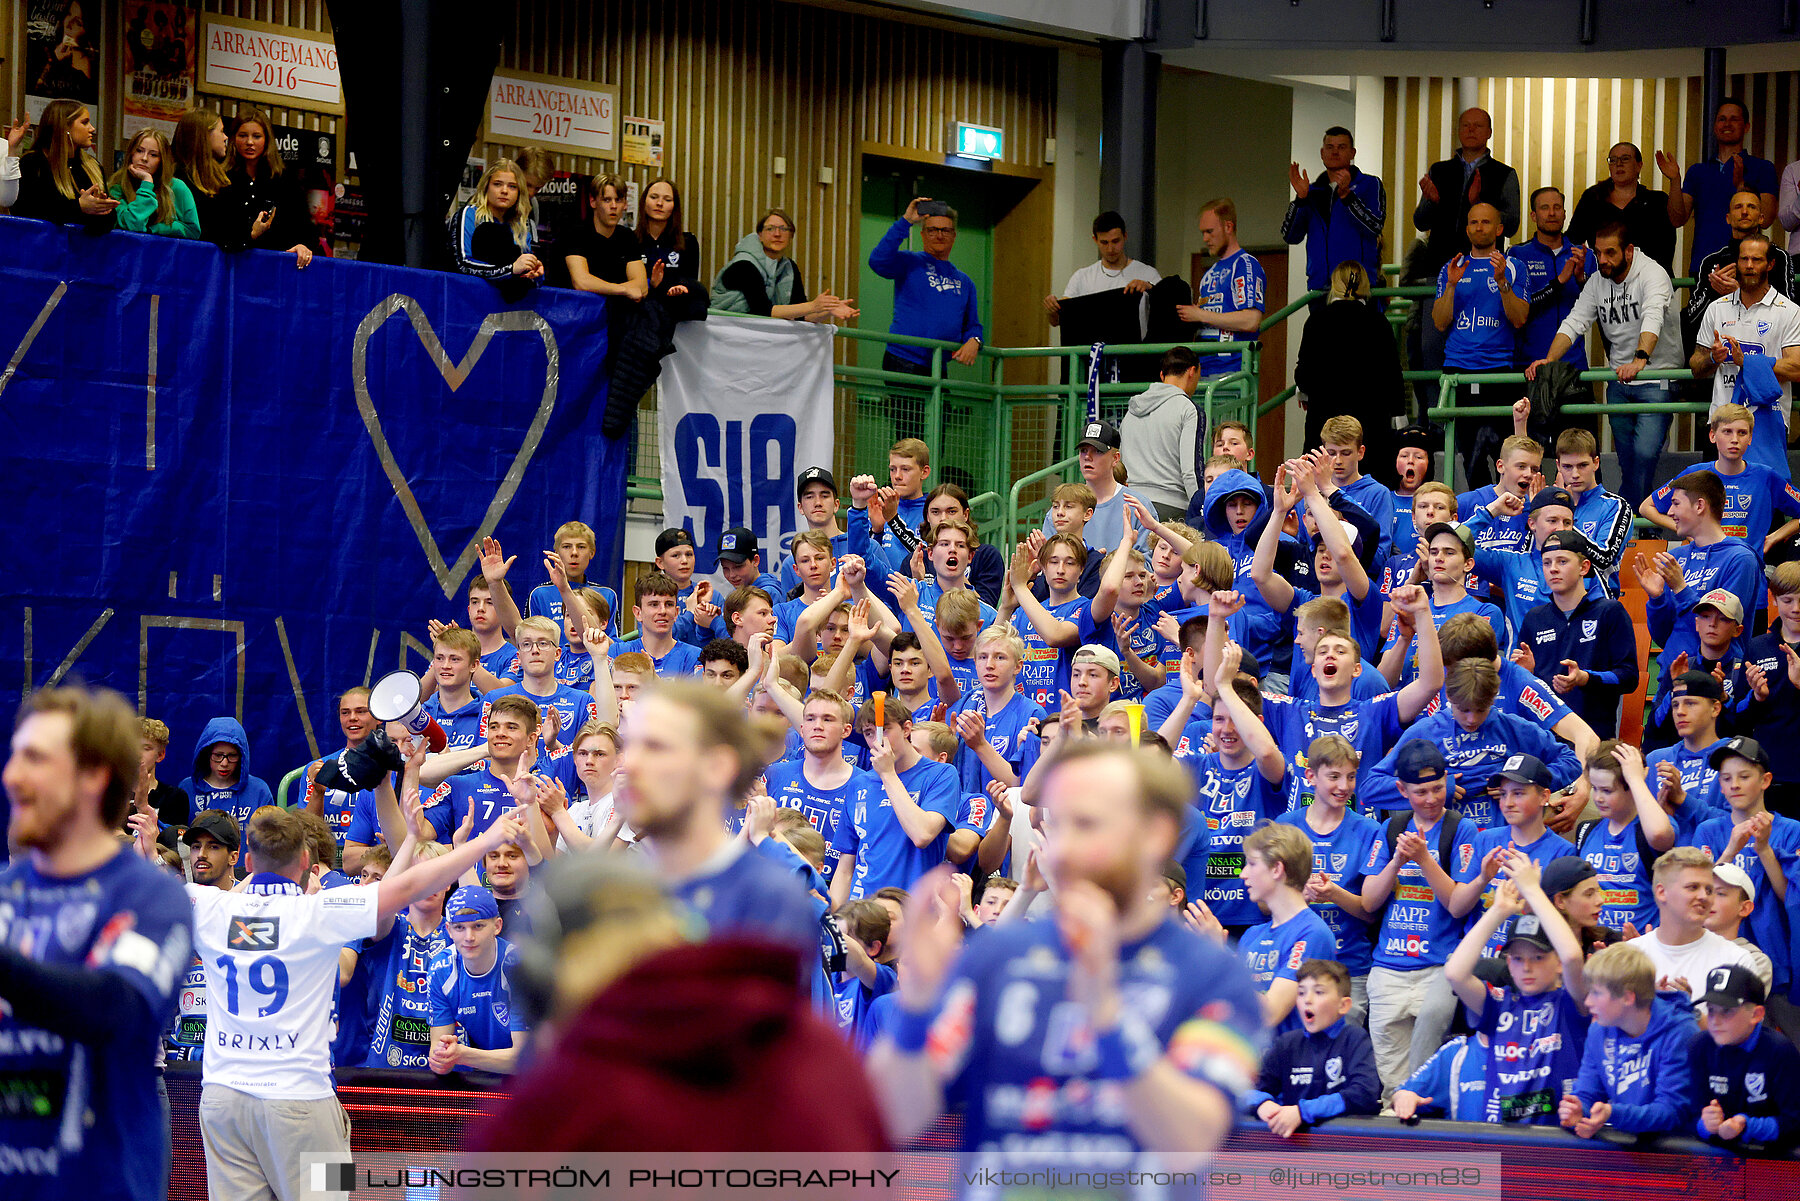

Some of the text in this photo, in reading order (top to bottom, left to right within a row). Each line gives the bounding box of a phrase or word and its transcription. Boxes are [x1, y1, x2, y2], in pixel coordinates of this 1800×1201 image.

[211, 30, 337, 71] ARRANGEMANG
[252, 62, 297, 90] 2016
[495, 83, 610, 118] ARRANGEMANG
[532, 113, 571, 137] 2017
[1477, 315, 1500, 328] Bilia
[1596, 301, 1640, 324] GANT
[1380, 567, 1392, 593] MAXI
[1396, 566, 1414, 586] 91
[1023, 665, 1055, 679] RAPP
[1521, 688, 1554, 719] MAXI
[423, 783, 452, 808] MAXI
[779, 796, 803, 811] 18
[857, 790, 867, 801] 12
[482, 800, 495, 820] 7
[1233, 812, 1253, 820] INTER
[1234, 818, 1253, 826] SPORT
[1586, 853, 1603, 868] 69
[1204, 888, 1244, 901] KÖVDE
[1389, 904, 1430, 923] RAPP
[231, 921, 275, 945] XR
[1388, 922, 1429, 932] FASTIGHETER
[1287, 941, 1306, 969] MAXI
[1386, 937, 1429, 954] DALOC
[216, 953, 290, 1018] 19
[401, 997, 428, 1011] VOL
[1496, 1011, 1513, 1032] 9
[218, 1031, 300, 1051] BRIXLY
[1498, 1065, 1551, 1084] VOLVO
